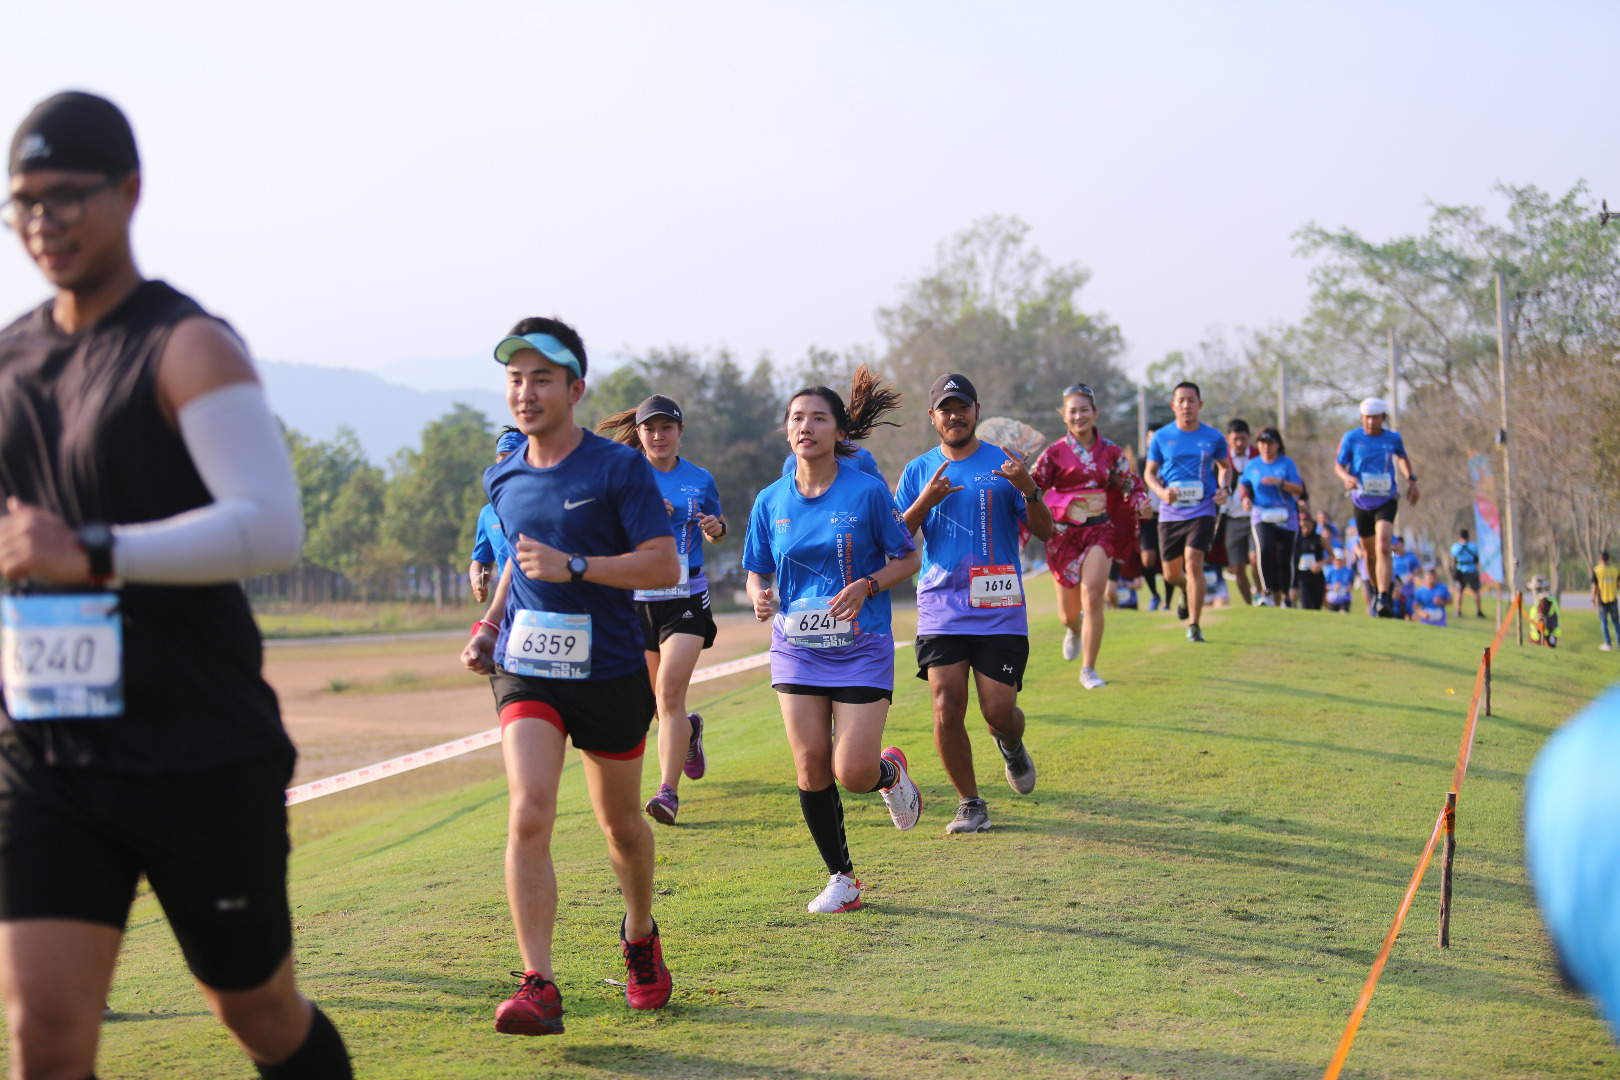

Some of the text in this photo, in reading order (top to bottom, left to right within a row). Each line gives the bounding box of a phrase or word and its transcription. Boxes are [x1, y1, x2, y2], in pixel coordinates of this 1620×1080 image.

[986, 580, 1012, 592] 1616
[852, 621, 861, 635] RAI
[522, 632, 576, 656] 6359
[570, 668, 580, 678] 16
